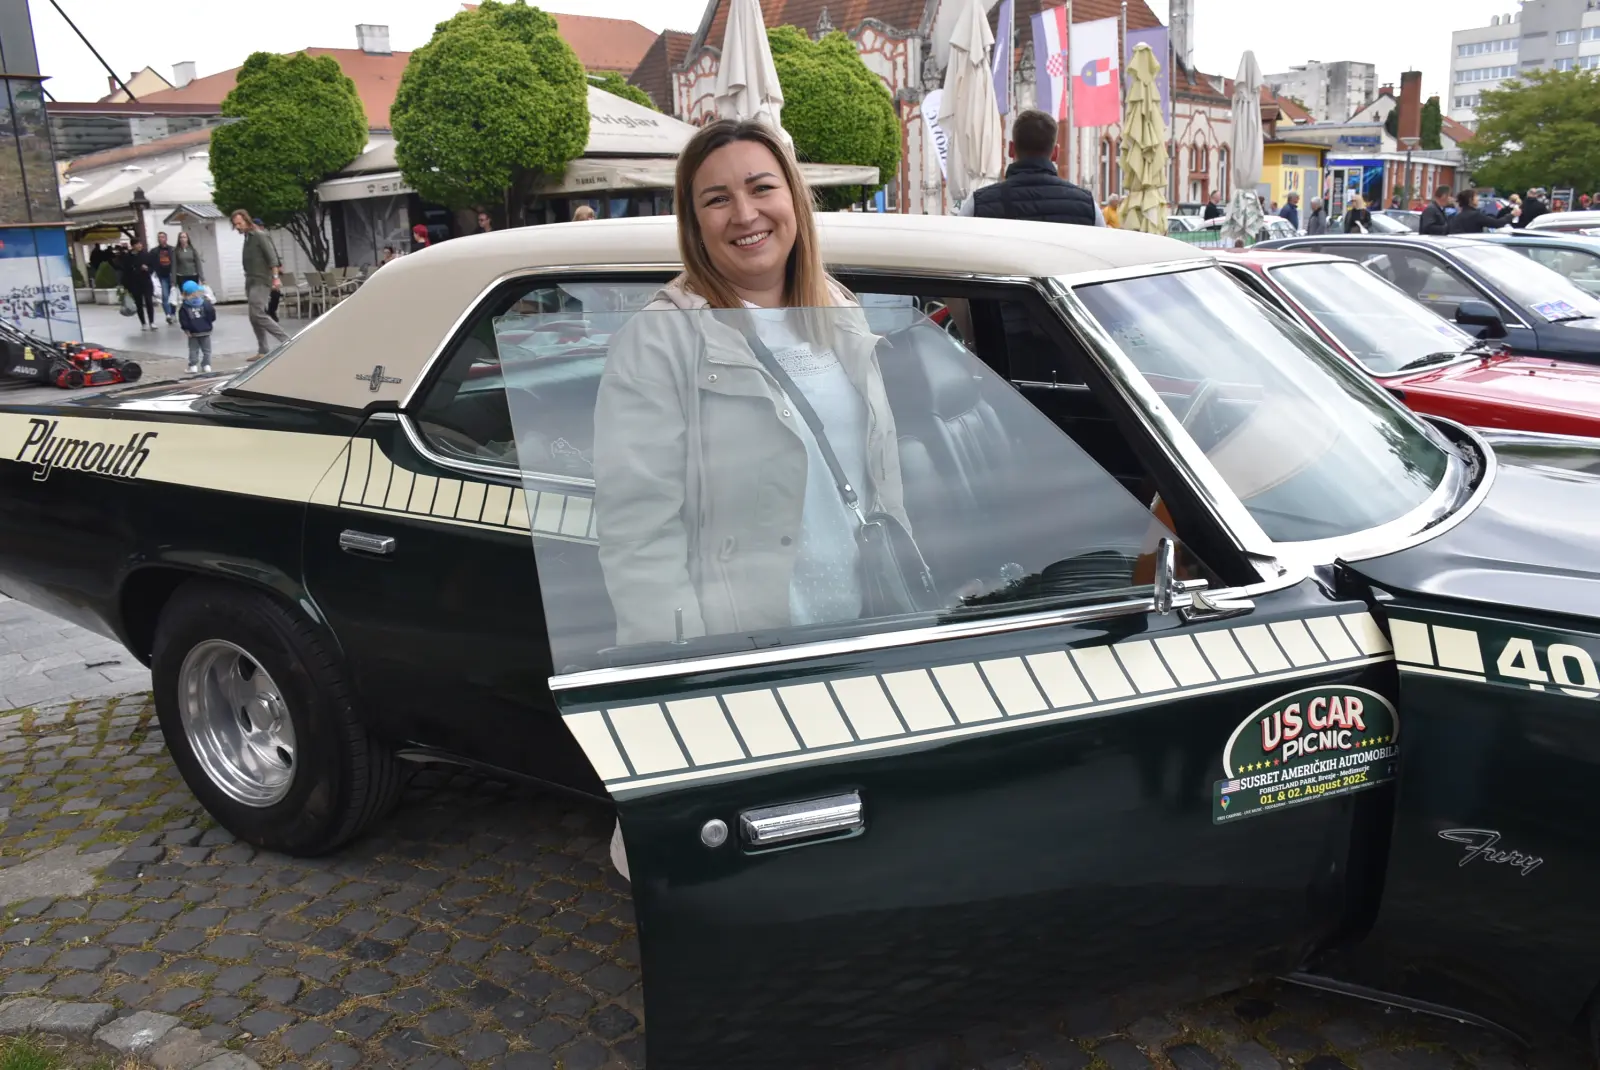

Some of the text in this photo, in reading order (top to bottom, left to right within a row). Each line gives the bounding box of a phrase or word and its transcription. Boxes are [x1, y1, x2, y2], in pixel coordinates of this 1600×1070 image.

[592, 113, 659, 129] triglav
[15, 418, 158, 481] Plymouth
[1261, 695, 1366, 752] US CAR
[1282, 729, 1352, 764] PICNIC
[1240, 770, 1280, 790] SUSRET
[1280, 758, 1338, 781] AMERIČKIH
[1259, 780, 1299, 795] FORESTLAND
[1318, 772, 1336, 782] Brezje
[1260, 793, 1275, 805] 01.
[1277, 791, 1286, 801] &
[1287, 787, 1303, 799] 02.
[1304, 778, 1341, 795] August
[1343, 772, 1369, 787] 2025.
[1438, 828, 1543, 876] Fury
